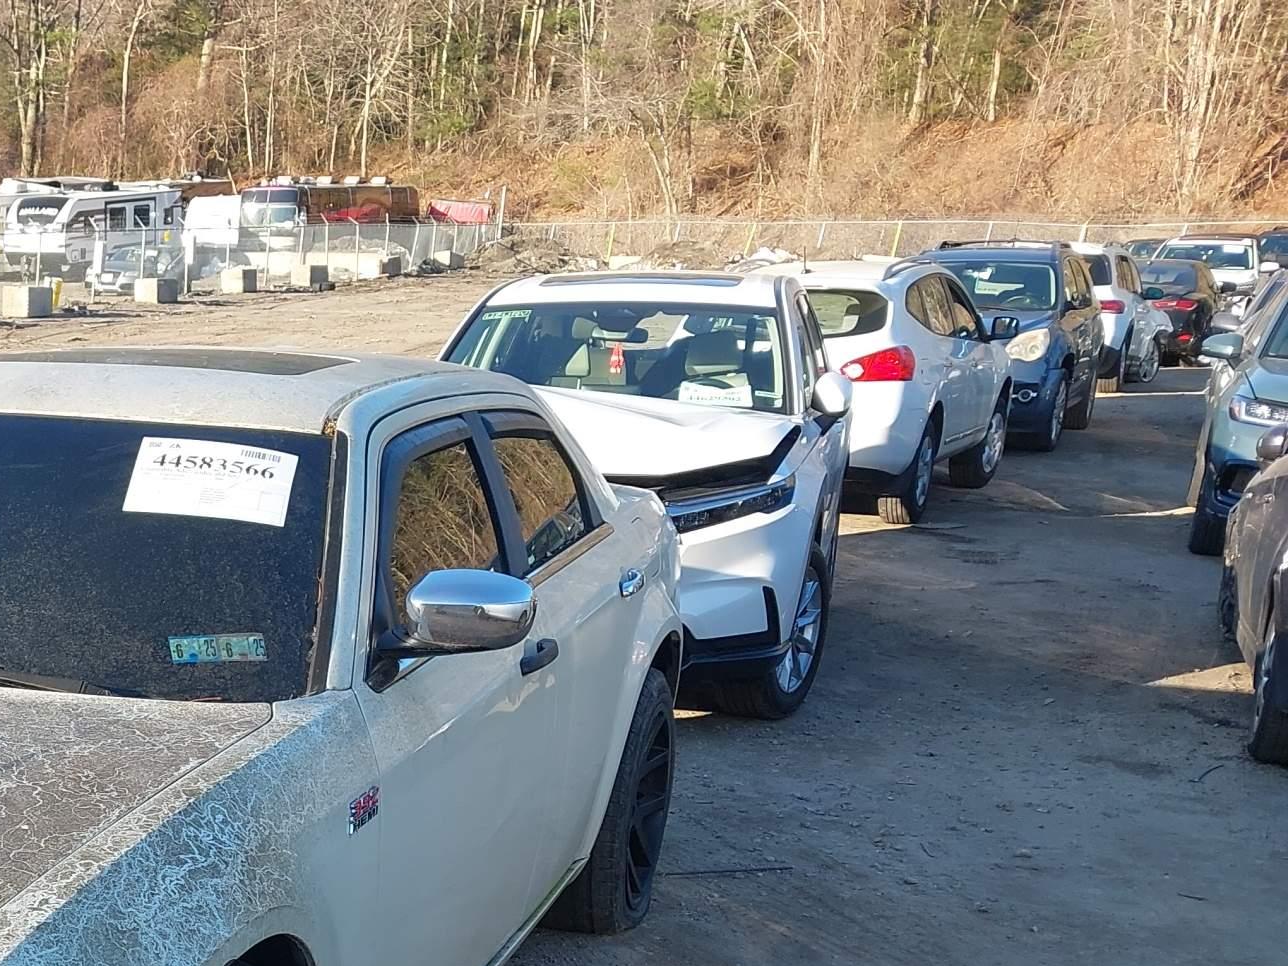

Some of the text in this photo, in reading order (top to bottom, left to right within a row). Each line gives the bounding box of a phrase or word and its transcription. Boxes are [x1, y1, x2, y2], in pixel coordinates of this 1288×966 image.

[152, 453, 276, 479] 44583566
[204, 639, 217, 657] 25
[254, 638, 267, 657] 25
